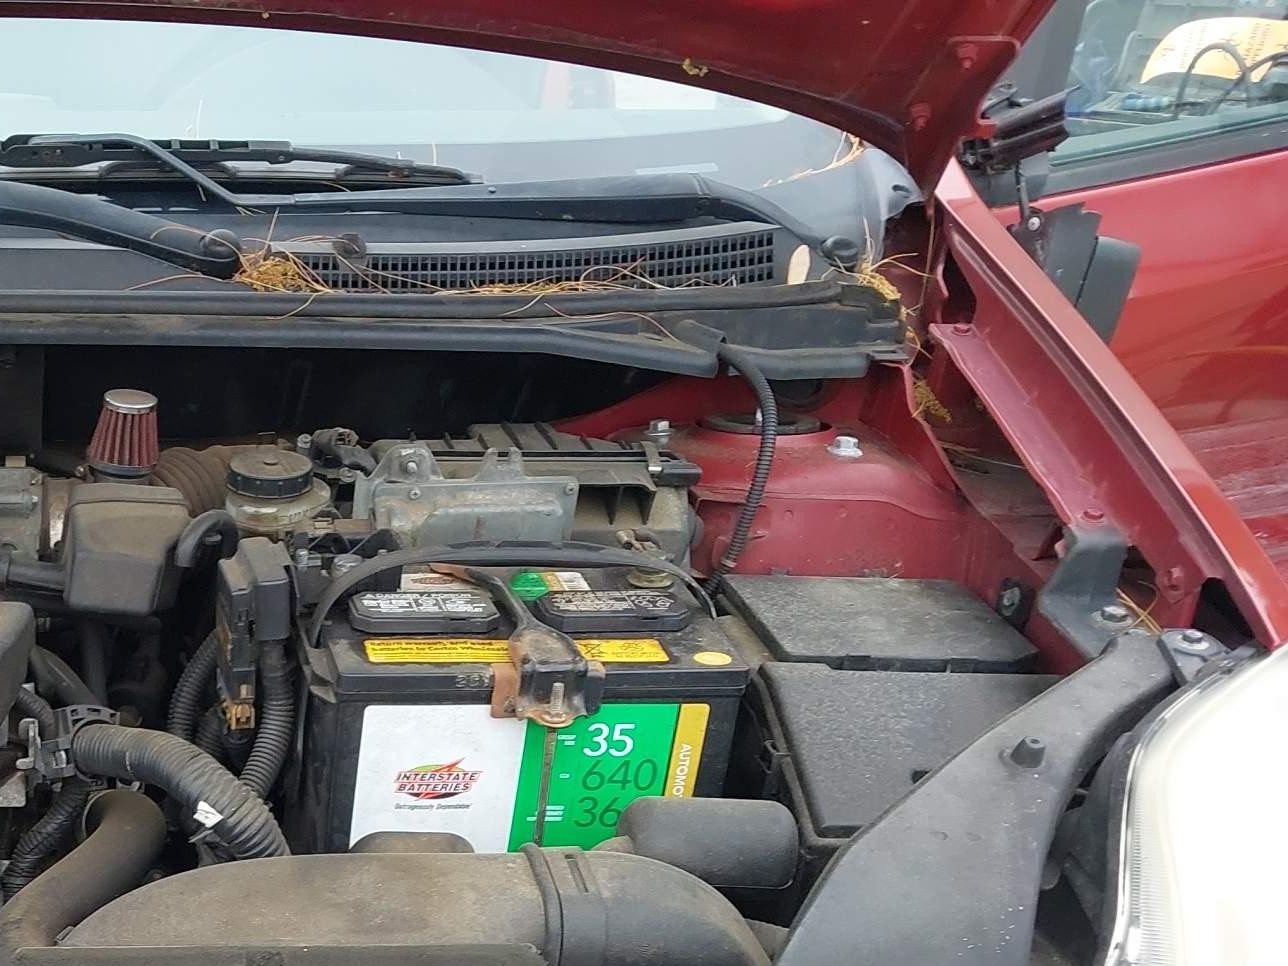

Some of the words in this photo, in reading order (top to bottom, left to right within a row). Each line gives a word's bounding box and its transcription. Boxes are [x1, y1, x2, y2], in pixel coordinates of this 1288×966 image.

[583, 723, 636, 757] 35
[396, 772, 479, 781] INTERSTATE
[582, 758, 658, 791] 640
[672, 743, 693, 798] AUTOMO
[398, 783, 470, 792] BATTERIES
